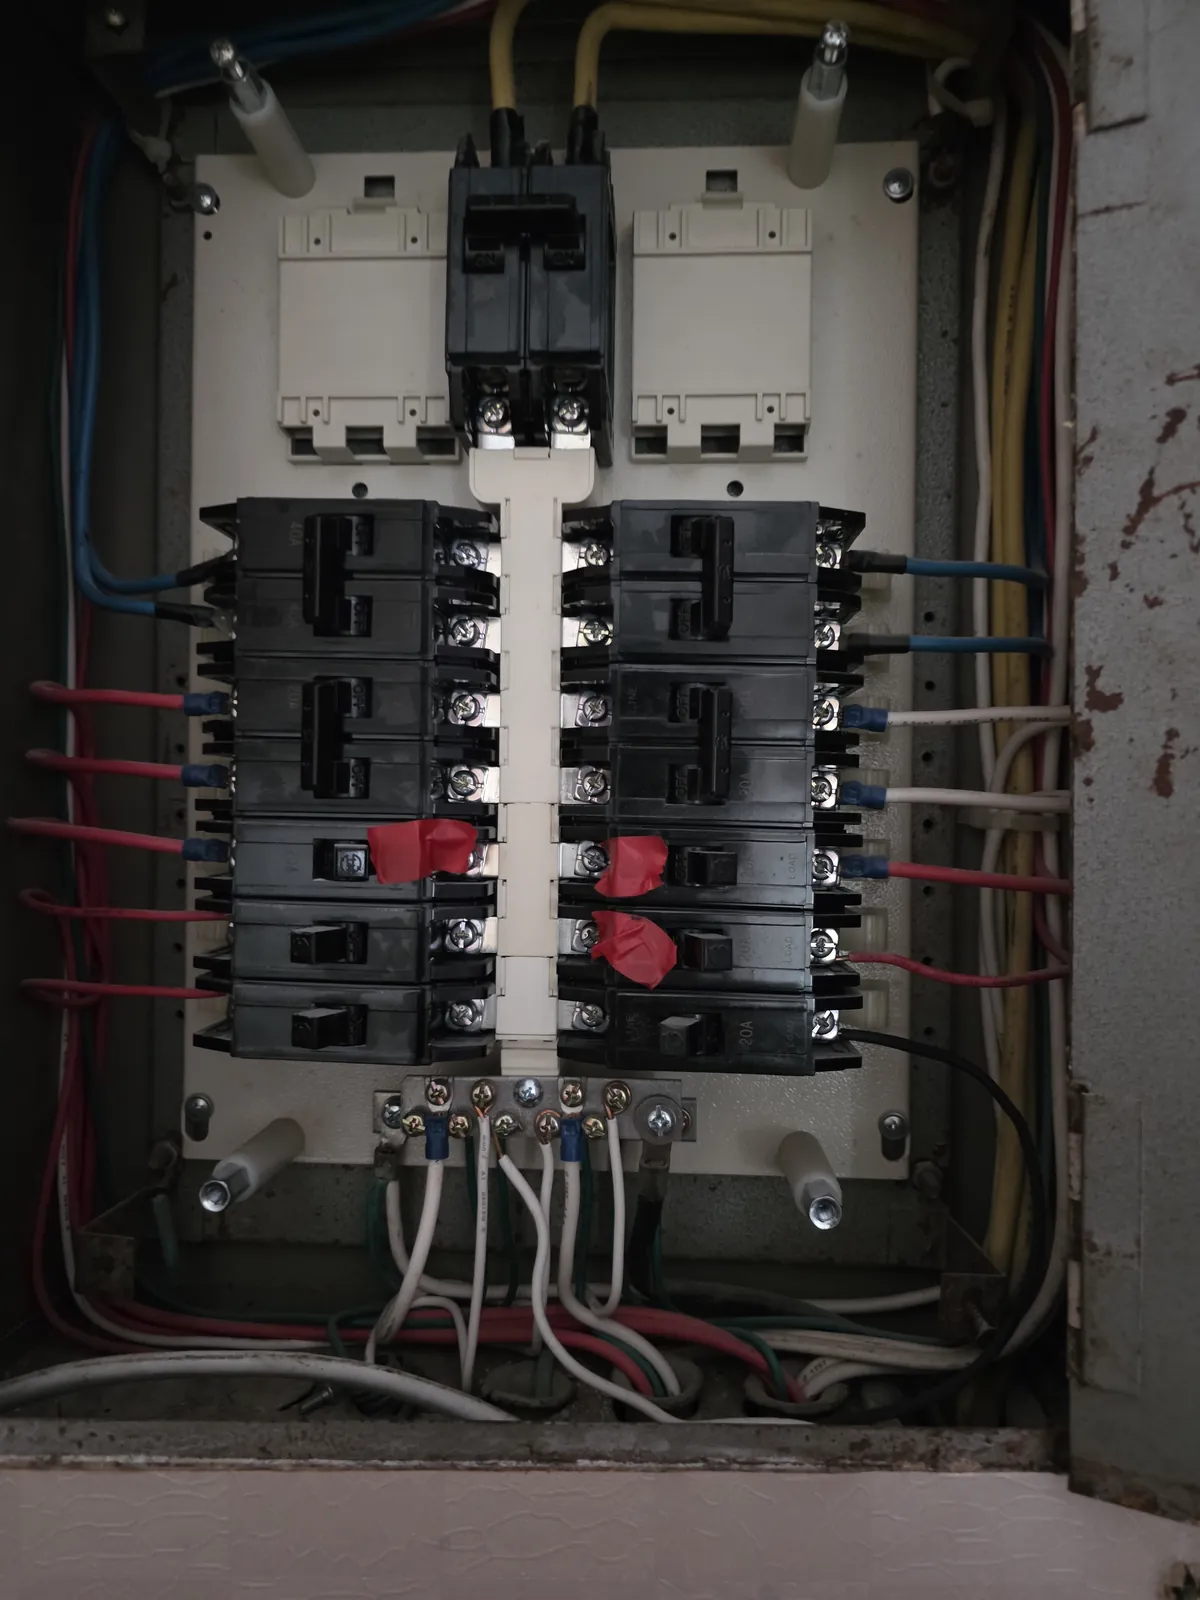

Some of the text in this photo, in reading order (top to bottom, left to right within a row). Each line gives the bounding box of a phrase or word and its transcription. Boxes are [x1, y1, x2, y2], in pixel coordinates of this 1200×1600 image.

[474, 253, 496, 268] ON
[289, 521, 304, 548] 40A
[677, 605, 690, 633] OFF
[353, 684, 366, 712] OFF
[676, 689, 688, 717] OFF
[675, 770, 688, 797] OFF
[786, 853, 797, 880] LOAD
[783, 936, 793, 964] LOAD
[739, 1021, 754, 1046] 20A
